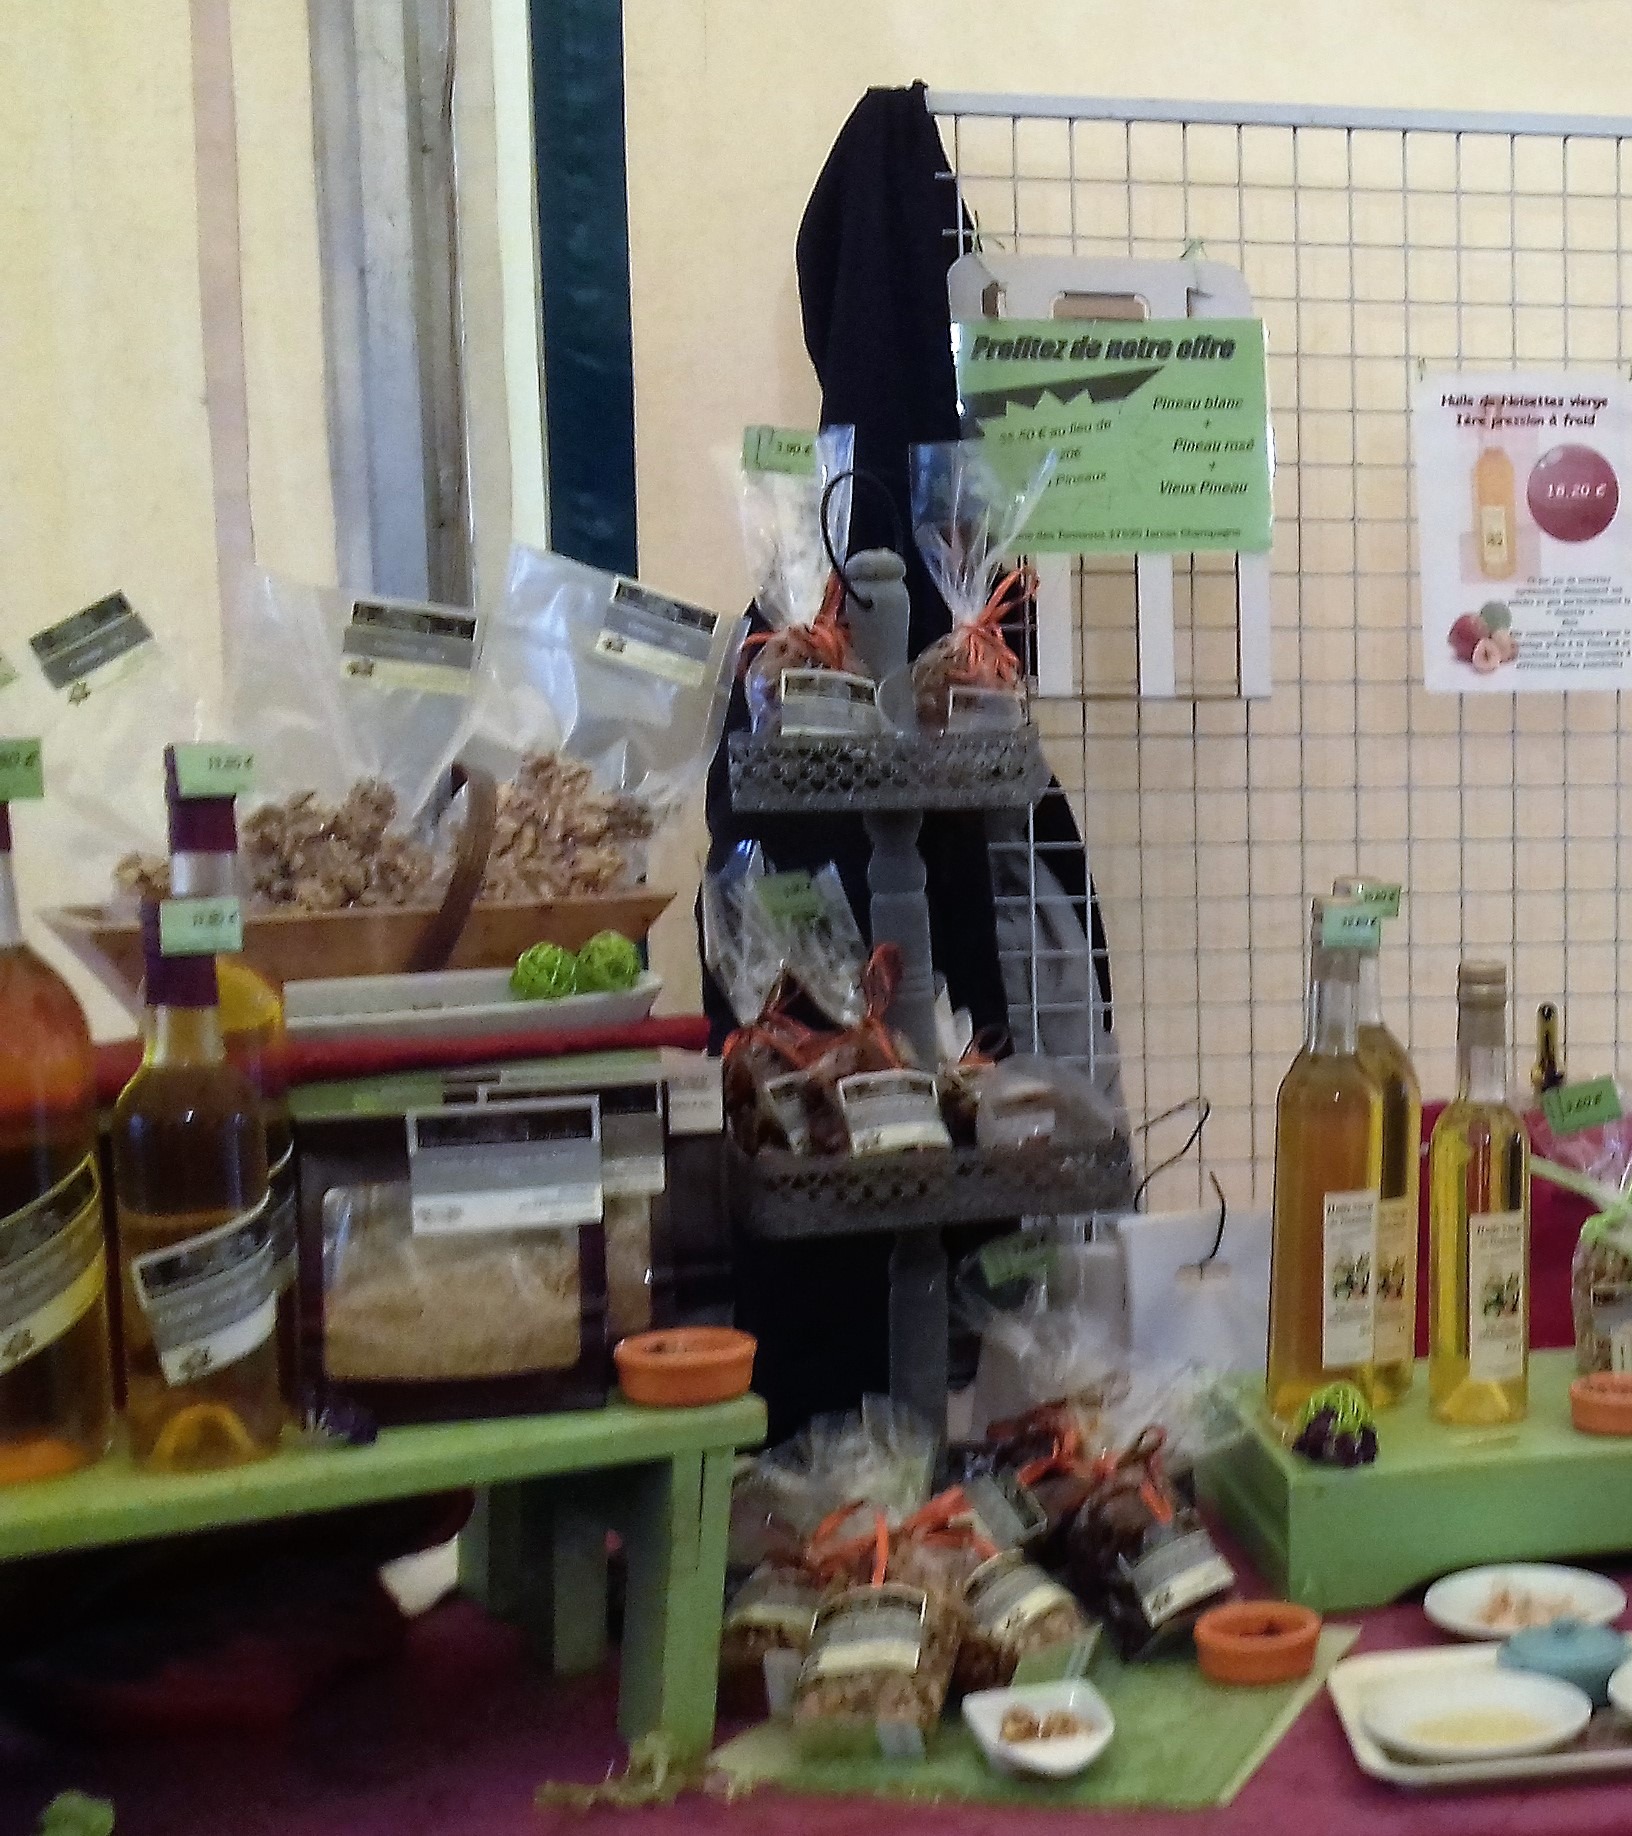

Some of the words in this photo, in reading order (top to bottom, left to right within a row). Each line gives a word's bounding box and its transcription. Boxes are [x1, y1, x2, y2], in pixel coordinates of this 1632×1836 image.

[971, 335, 1068, 360] Profitez
[1069, 335, 1102, 360] de
[1104, 336, 1173, 360] notre
[1175, 335, 1237, 360] offre
[1152, 395, 1202, 411] Pineau
[1204, 396, 1244, 410] blanc
[1441, 394, 1474, 407] Huile
[1569, 394, 1609, 410] vierge
[1490, 413, 1545, 429] pression
[1563, 413, 1598, 427] froid
[1172, 438, 1222, 454] Pineau
[1158, 480, 1197, 496] Vieux
[1199, 480, 1249, 495] Pineau
